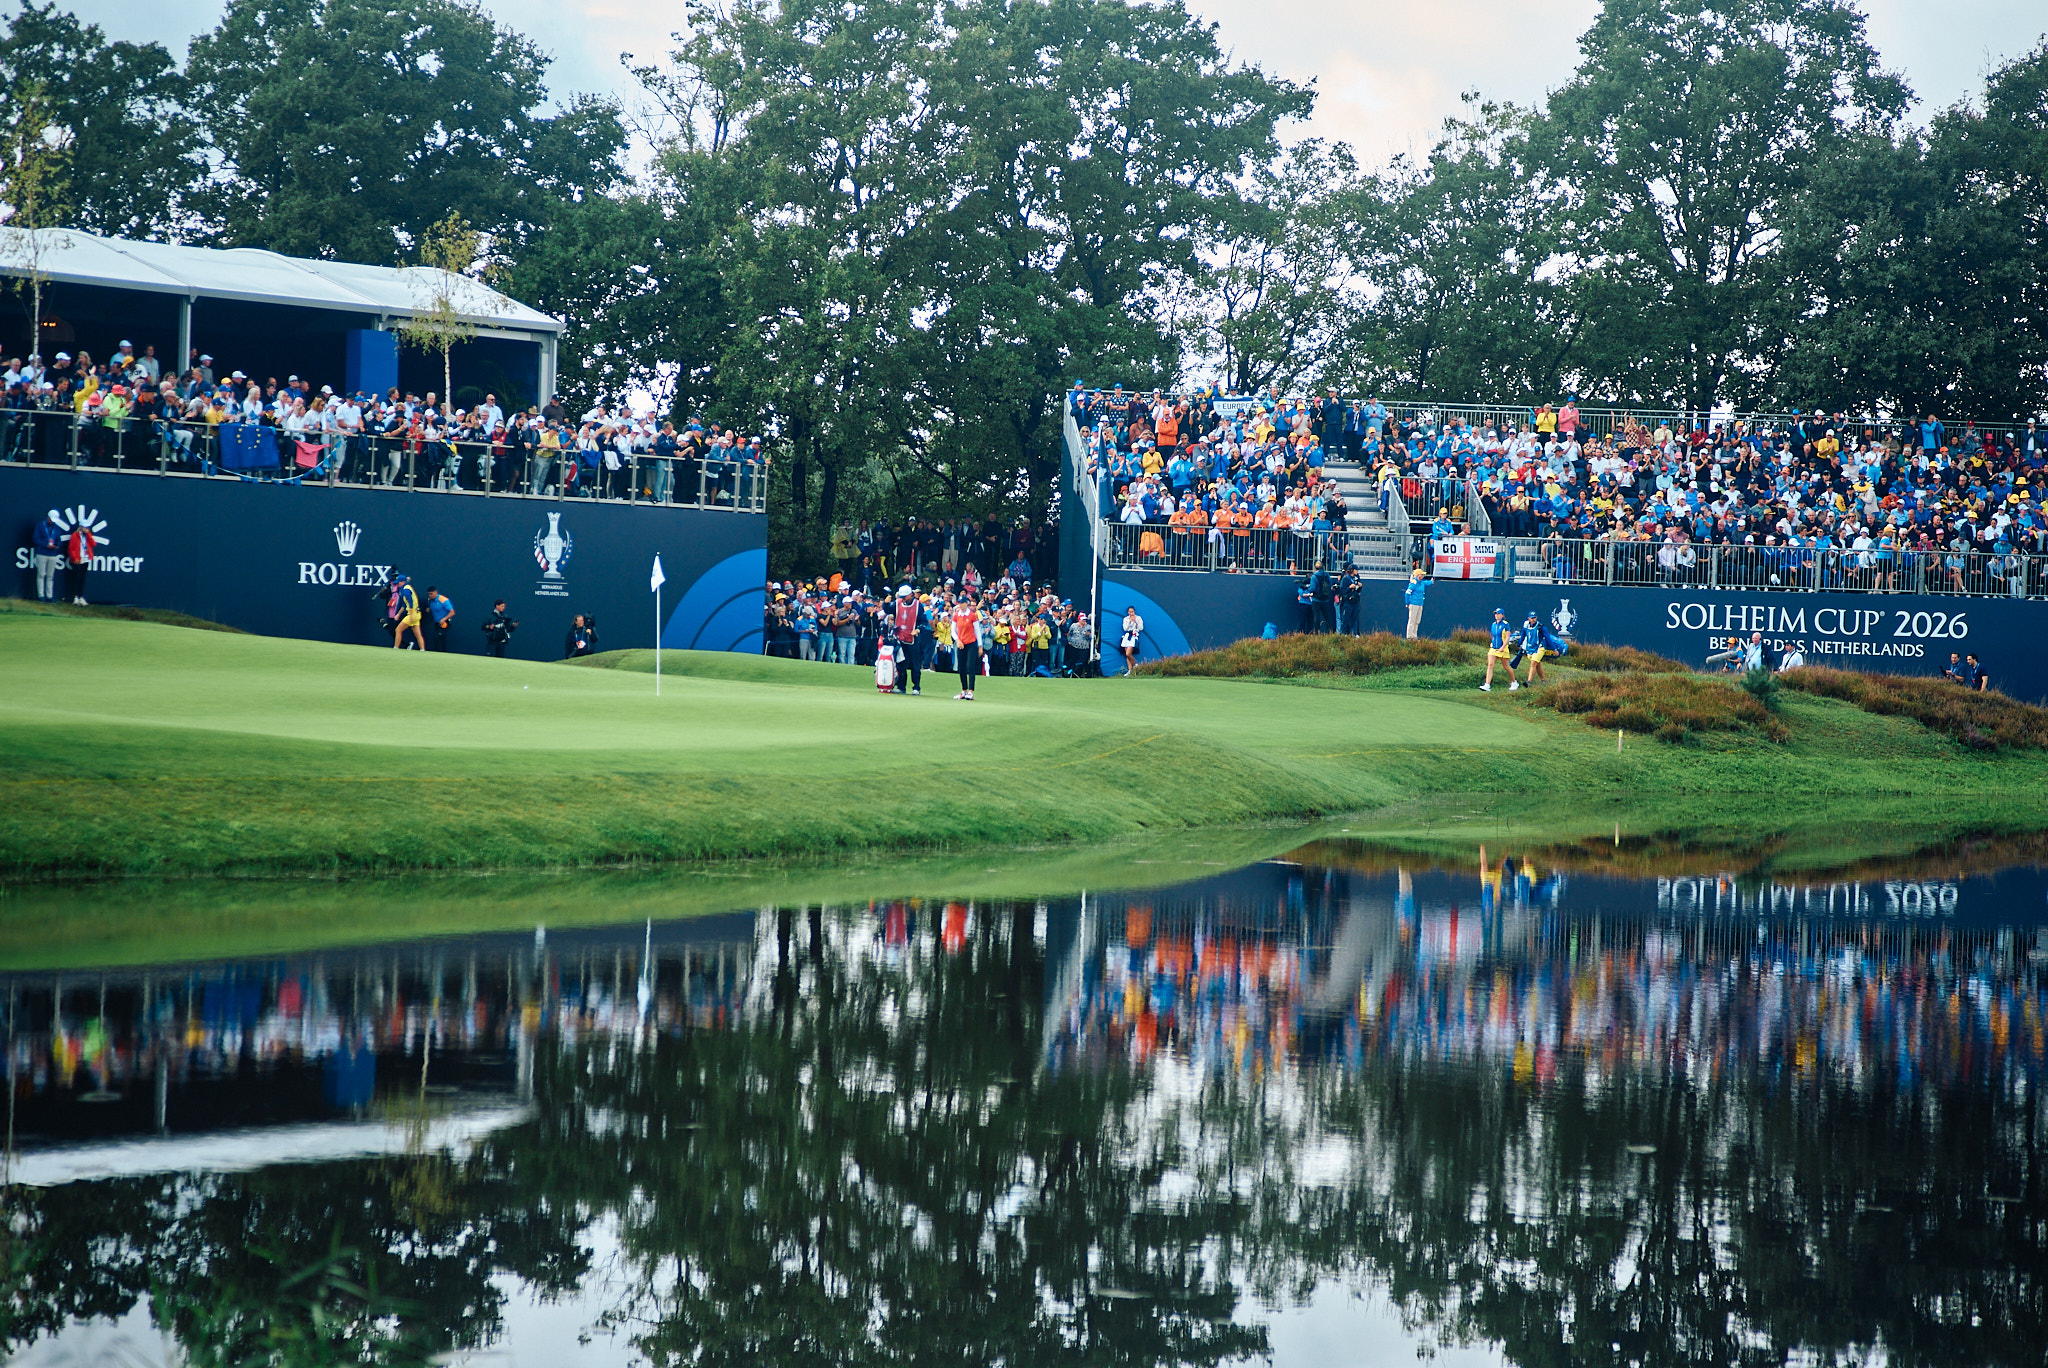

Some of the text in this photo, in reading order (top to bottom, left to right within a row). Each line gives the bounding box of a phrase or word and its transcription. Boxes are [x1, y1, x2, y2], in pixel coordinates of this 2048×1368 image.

[1442, 543, 1494, 554] GO MIMI
[1447, 556, 1486, 564] ENGLAND
[297, 562, 392, 587] ROLEX
[1666, 602, 1808, 633] SOLHEIM
[1893, 610, 1969, 639] 2026
[1812, 640, 1925, 658] NETHERLANDS
